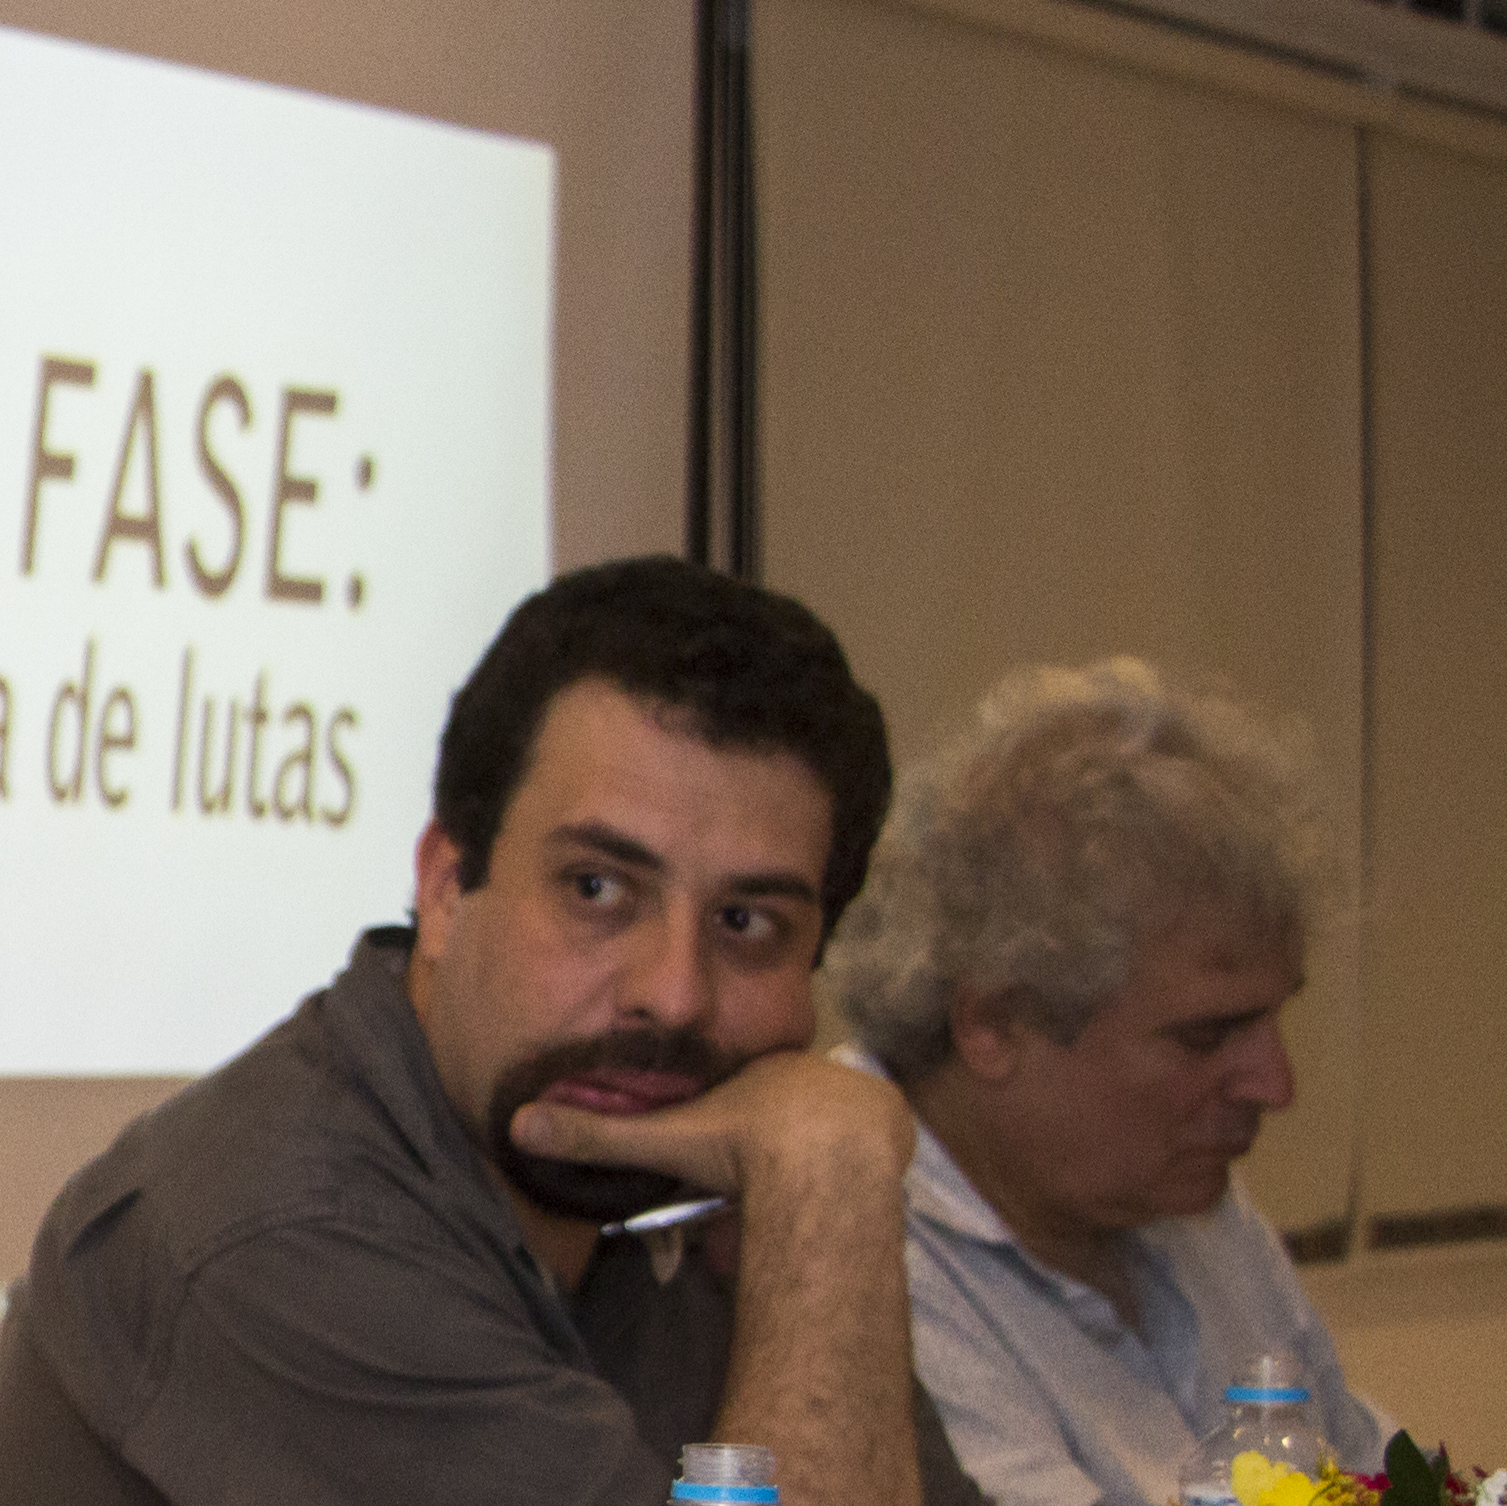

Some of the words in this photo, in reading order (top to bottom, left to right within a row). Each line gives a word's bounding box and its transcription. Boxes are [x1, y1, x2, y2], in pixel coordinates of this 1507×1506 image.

[21, 350, 377, 613] FASE:
[46, 633, 139, 811] de
[170, 642, 361, 830] lutas
